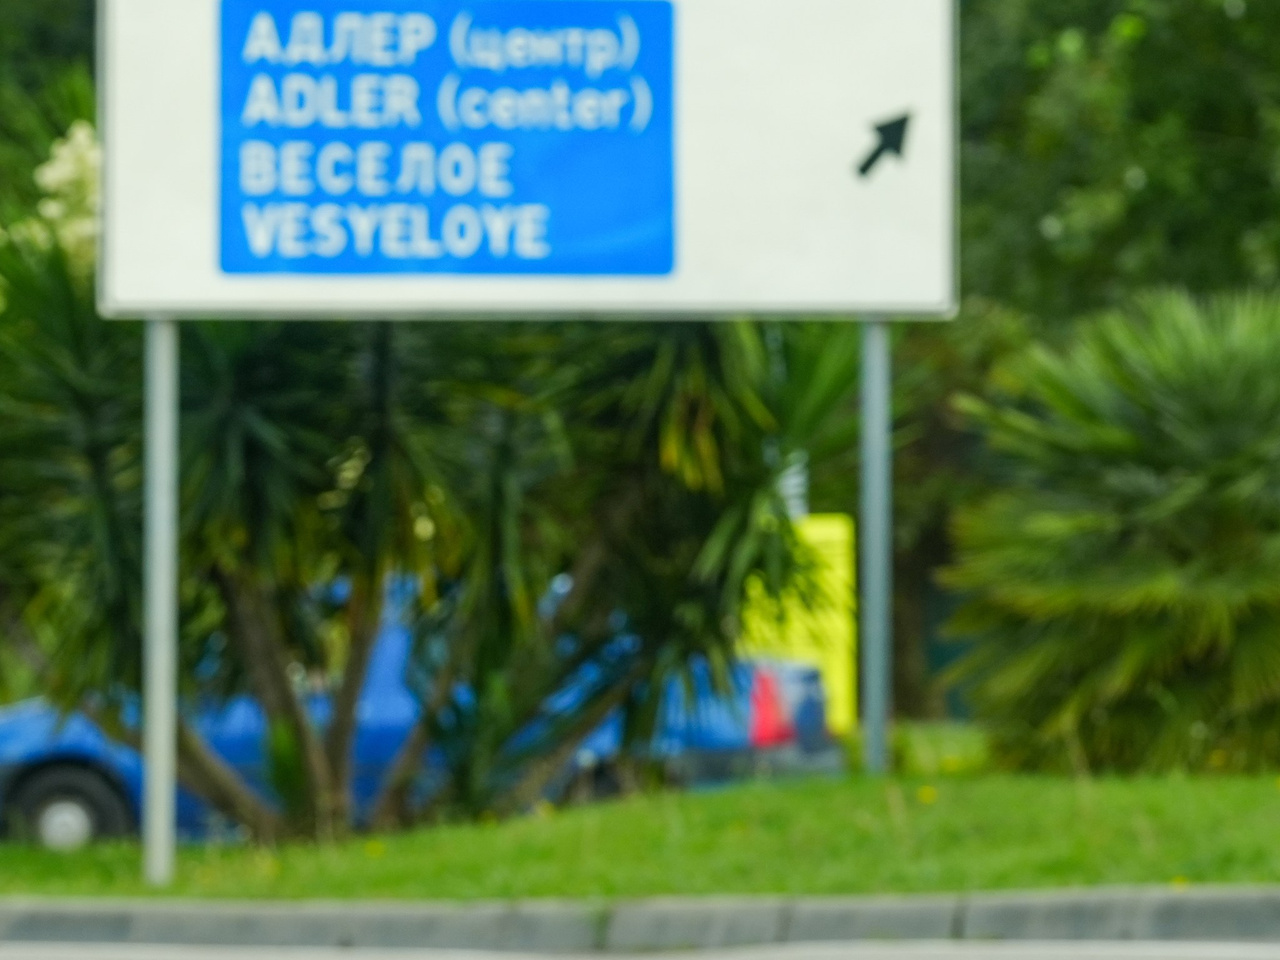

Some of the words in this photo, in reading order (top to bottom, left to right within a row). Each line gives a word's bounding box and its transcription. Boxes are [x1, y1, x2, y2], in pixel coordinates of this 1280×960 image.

[241, 12, 436, 68] АДЛЕР
[448, 14, 640, 76] (центр)
[241, 73, 421, 128] ADLER
[435, 77, 652, 132] (center)
[240, 140, 511, 196] ВЕСЕЛОЕ
[242, 202, 549, 258] VESYELOYE
